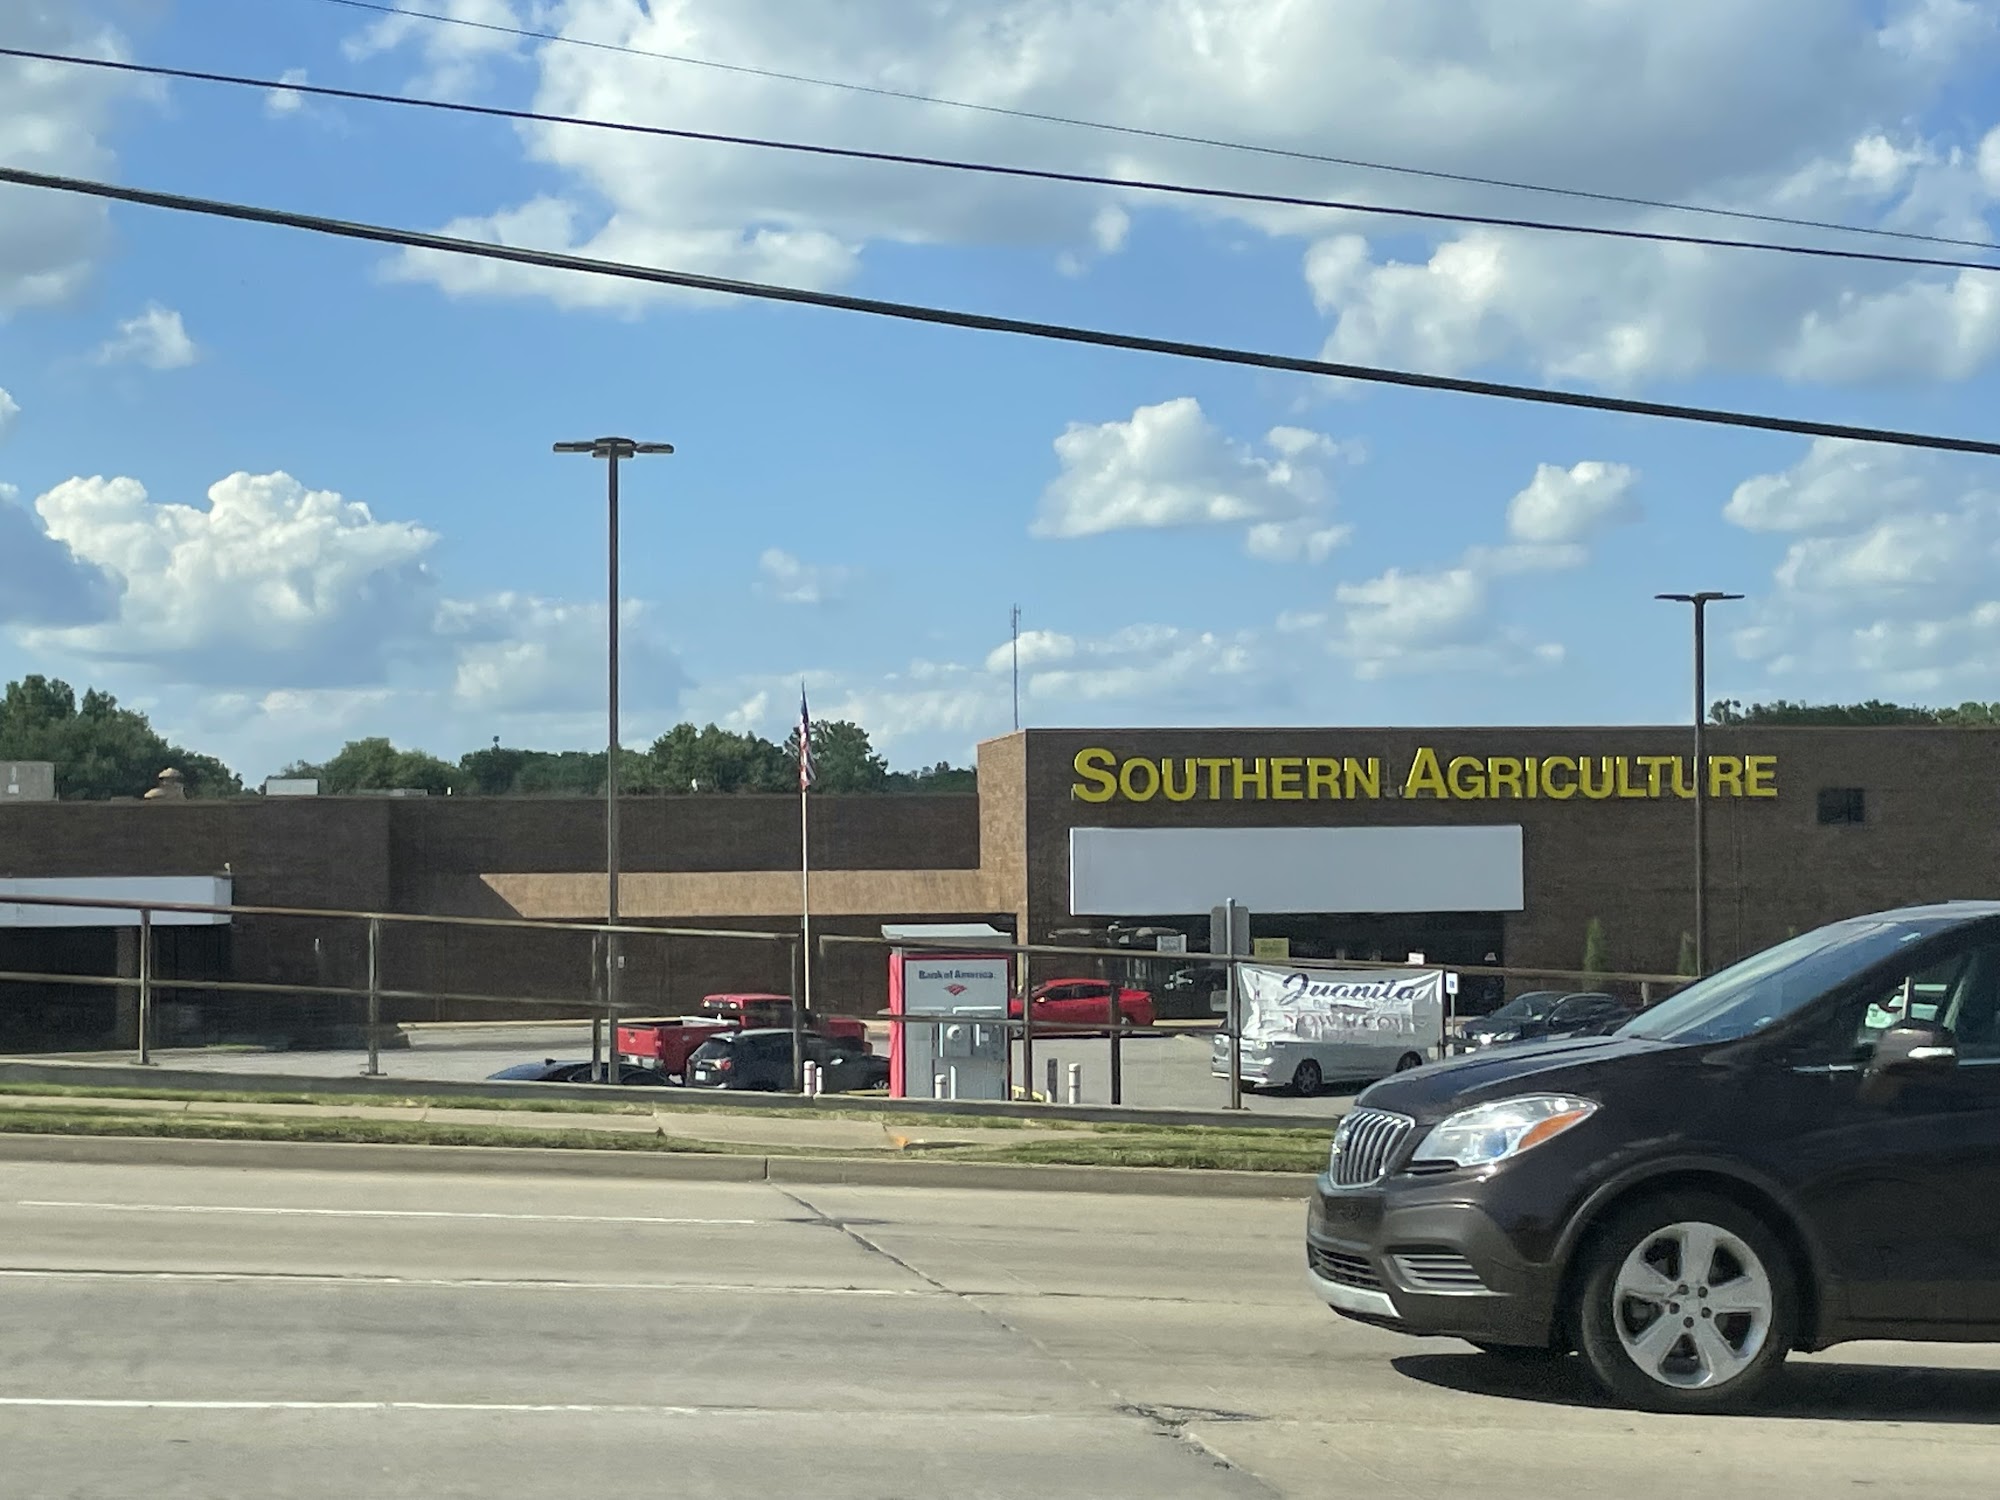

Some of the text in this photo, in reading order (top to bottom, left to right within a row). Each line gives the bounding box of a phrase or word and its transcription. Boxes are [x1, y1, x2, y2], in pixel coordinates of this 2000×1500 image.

[1073, 747, 1778, 802] SOUTHERN AGRICULTURE
[919, 969, 942, 979] Bank
[943, 969, 953, 979] of
